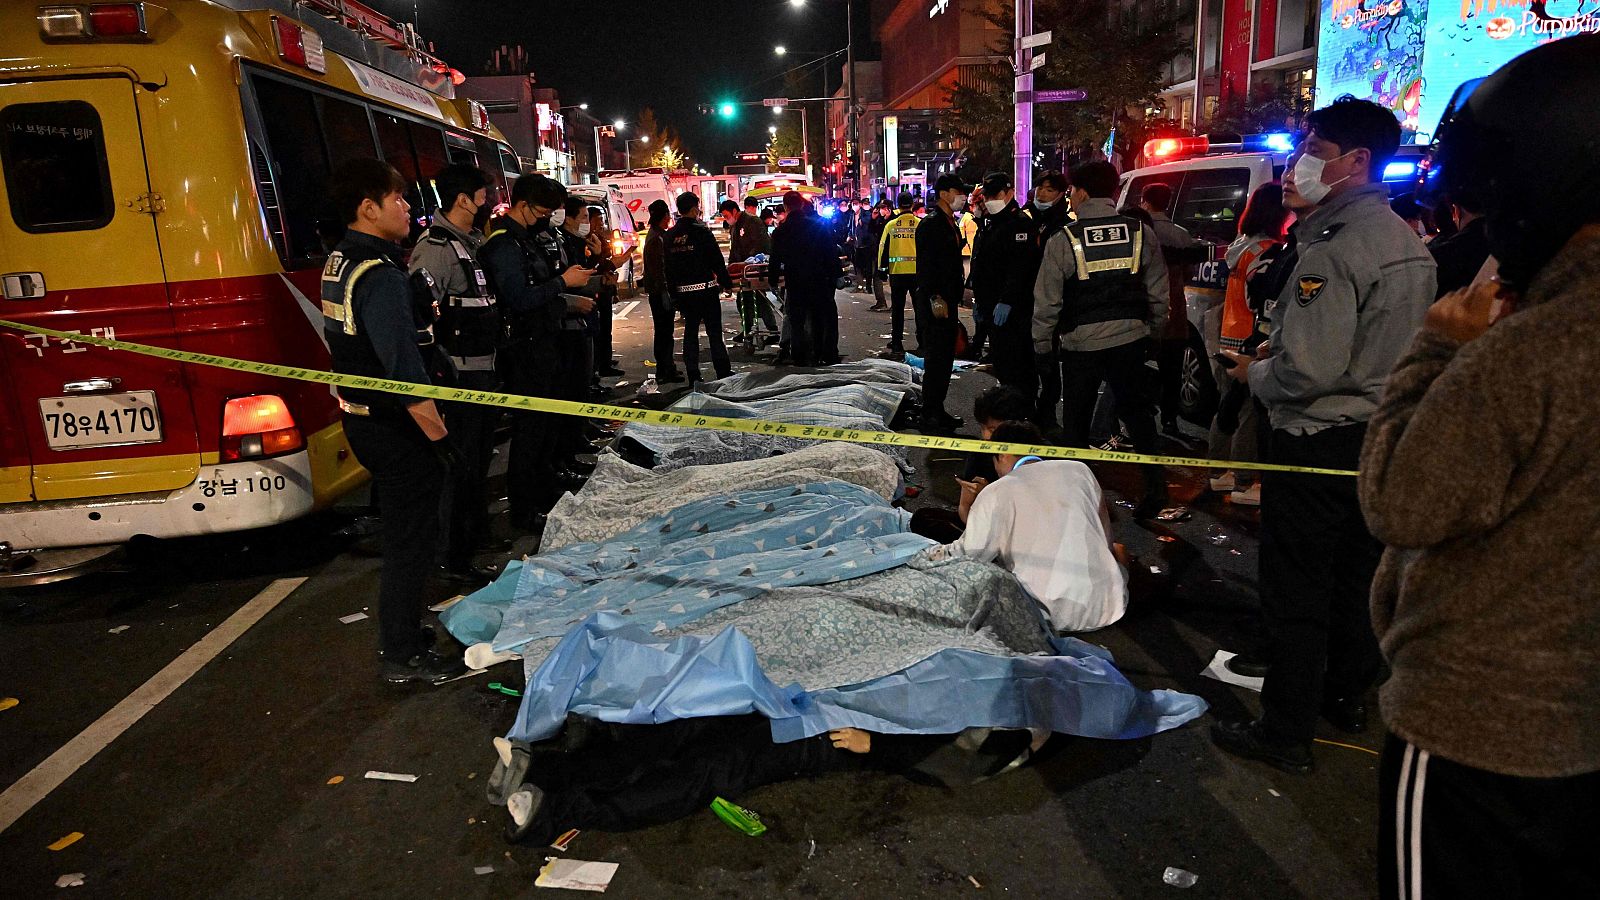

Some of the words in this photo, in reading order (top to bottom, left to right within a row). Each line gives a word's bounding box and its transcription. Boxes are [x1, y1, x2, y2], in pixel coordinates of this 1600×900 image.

[1091, 228, 1121, 242] 경찰
[351, 378, 378, 388] LINE!
[380, 381, 415, 393] POLICE
[46, 407, 155, 438] 78우4170
[199, 478, 238, 497] 강남
[246, 475, 286, 492] 100
